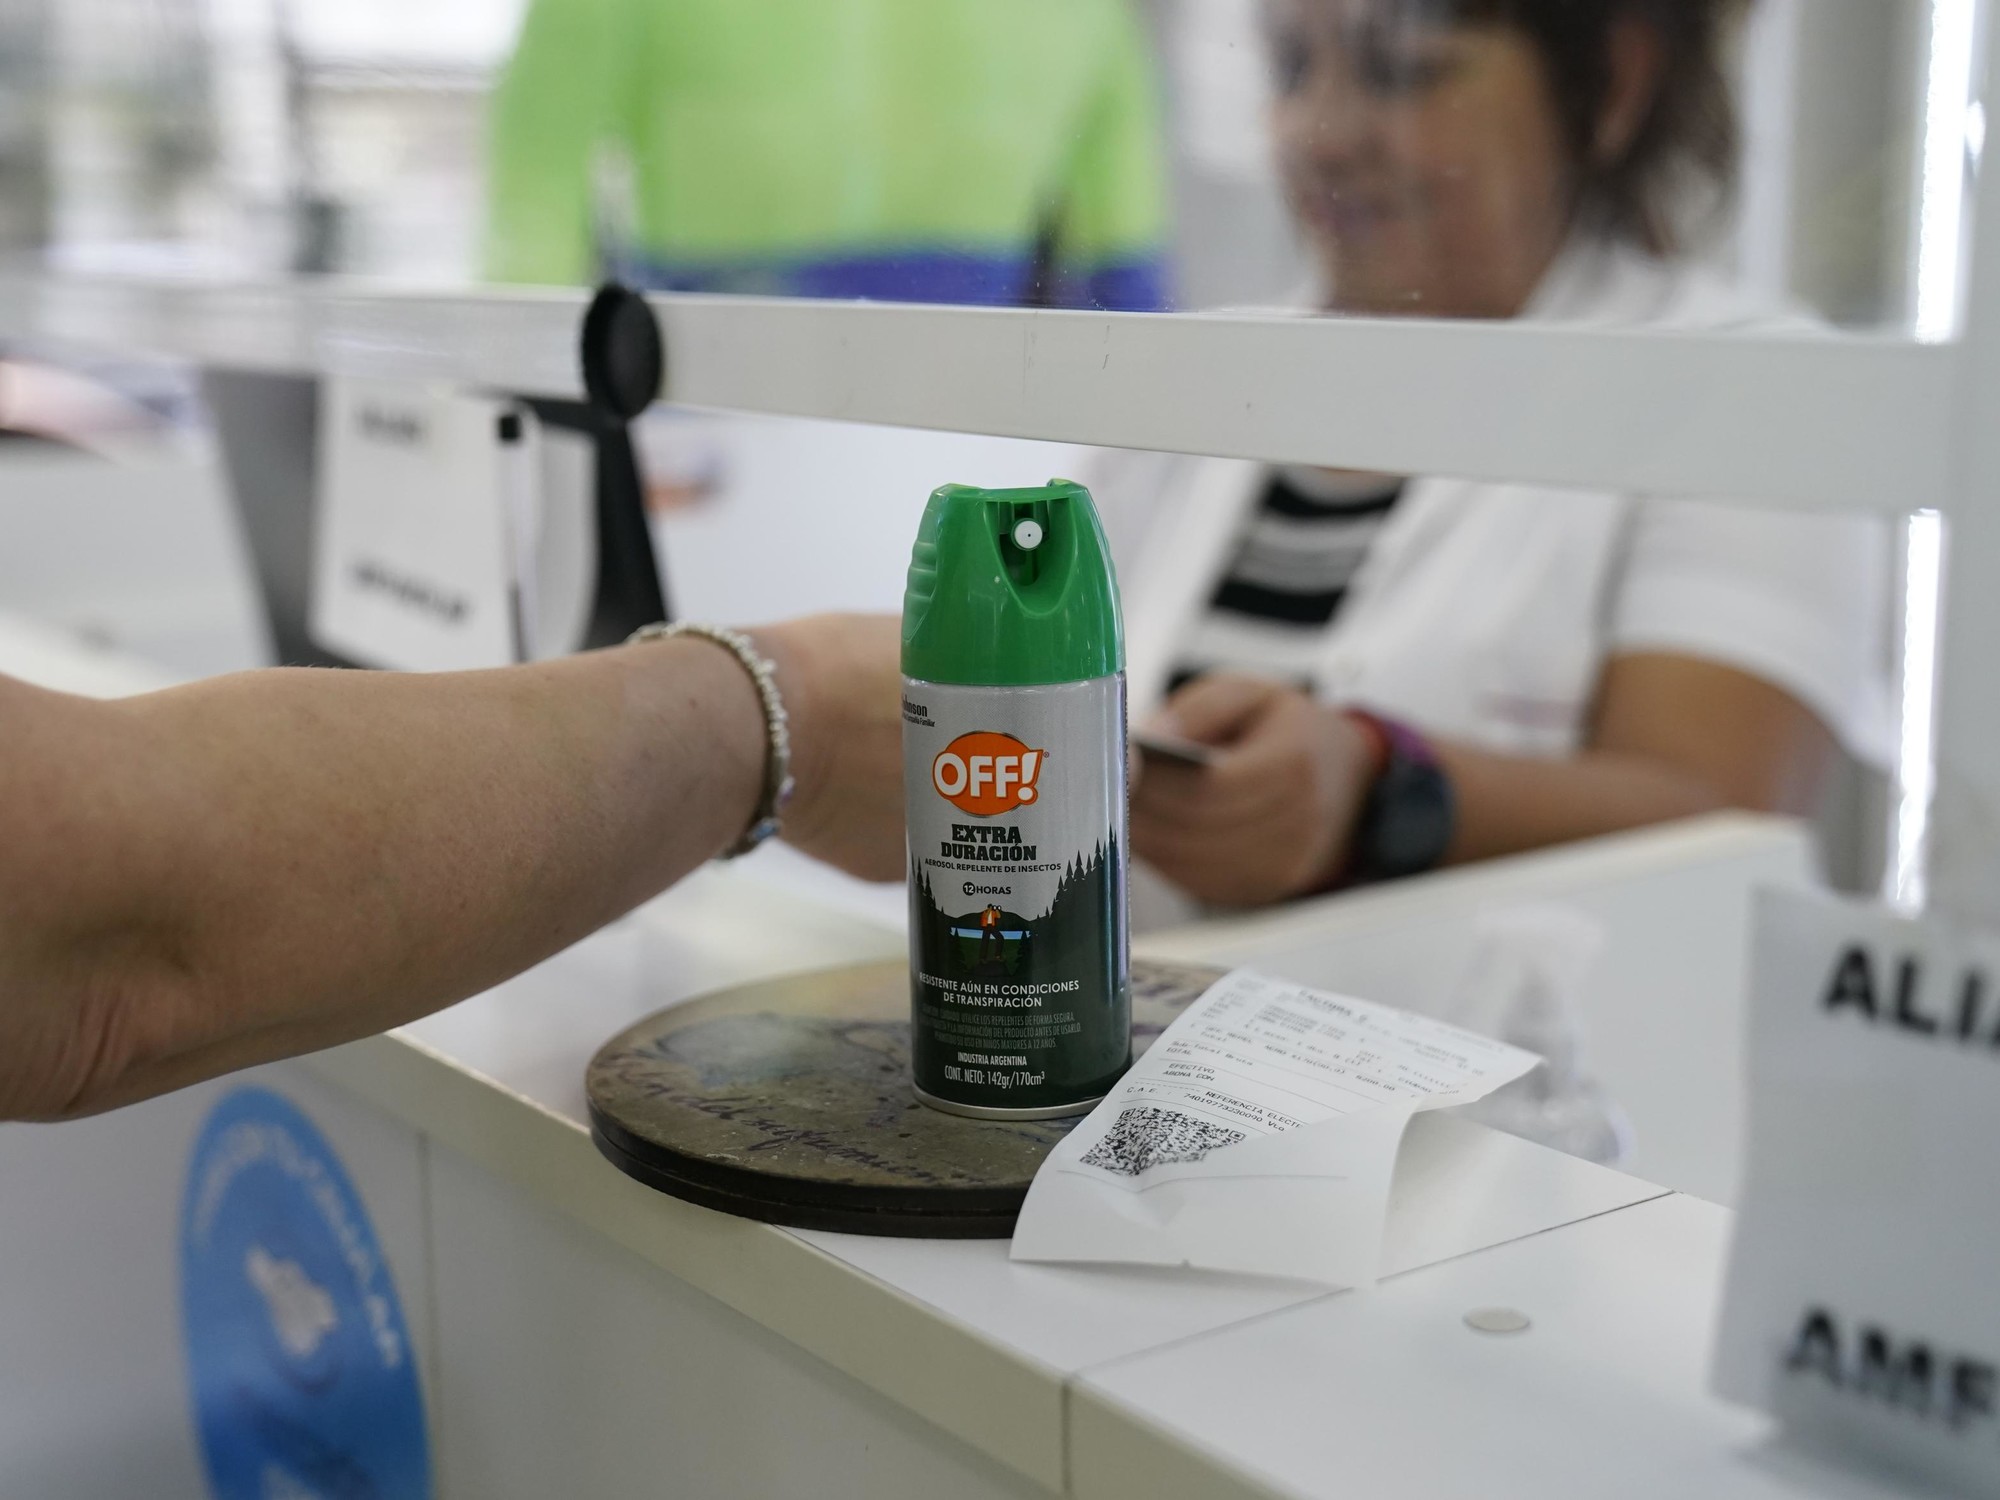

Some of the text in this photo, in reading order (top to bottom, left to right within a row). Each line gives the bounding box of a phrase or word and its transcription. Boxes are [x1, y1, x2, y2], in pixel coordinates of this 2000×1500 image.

[933, 751, 1038, 801] OFF!
[951, 823, 1022, 844] EXTRA
[941, 842, 1037, 862] DURACIÓN
[924, 857, 1062, 873] AEROSOL REPELENTE DE INSECTOS
[976, 885, 1012, 895] HORAS
[919, 971, 1080, 995] RESISTENTE AÚN EN CONDICIONES
[943, 992, 1043, 1008] DE TRANSPIRACIÓN
[1822, 942, 2000, 1056] ALI
[991, 1014, 1024, 1026] REPELENTES
[1025, 1015, 1033, 1026] DE
[1033, 1014, 1053, 1026] FORMA
[993, 1027, 1004, 1038] DEL
[1004, 1026, 1035, 1038] PRODUCTO
[1035, 1025, 1053, 1037] ANTES
[1053, 1024, 1060, 1036] DE
[957, 1051, 1028, 1066] INDUSTRIA ARGENTINA
[944, 1065, 964, 1082] CONT.
[964, 1068, 986, 1085] NETO:
[1168, 1062, 1215, 1074] EFECTIVO
[1205, 1090, 1264, 1115] REFERENCIA
